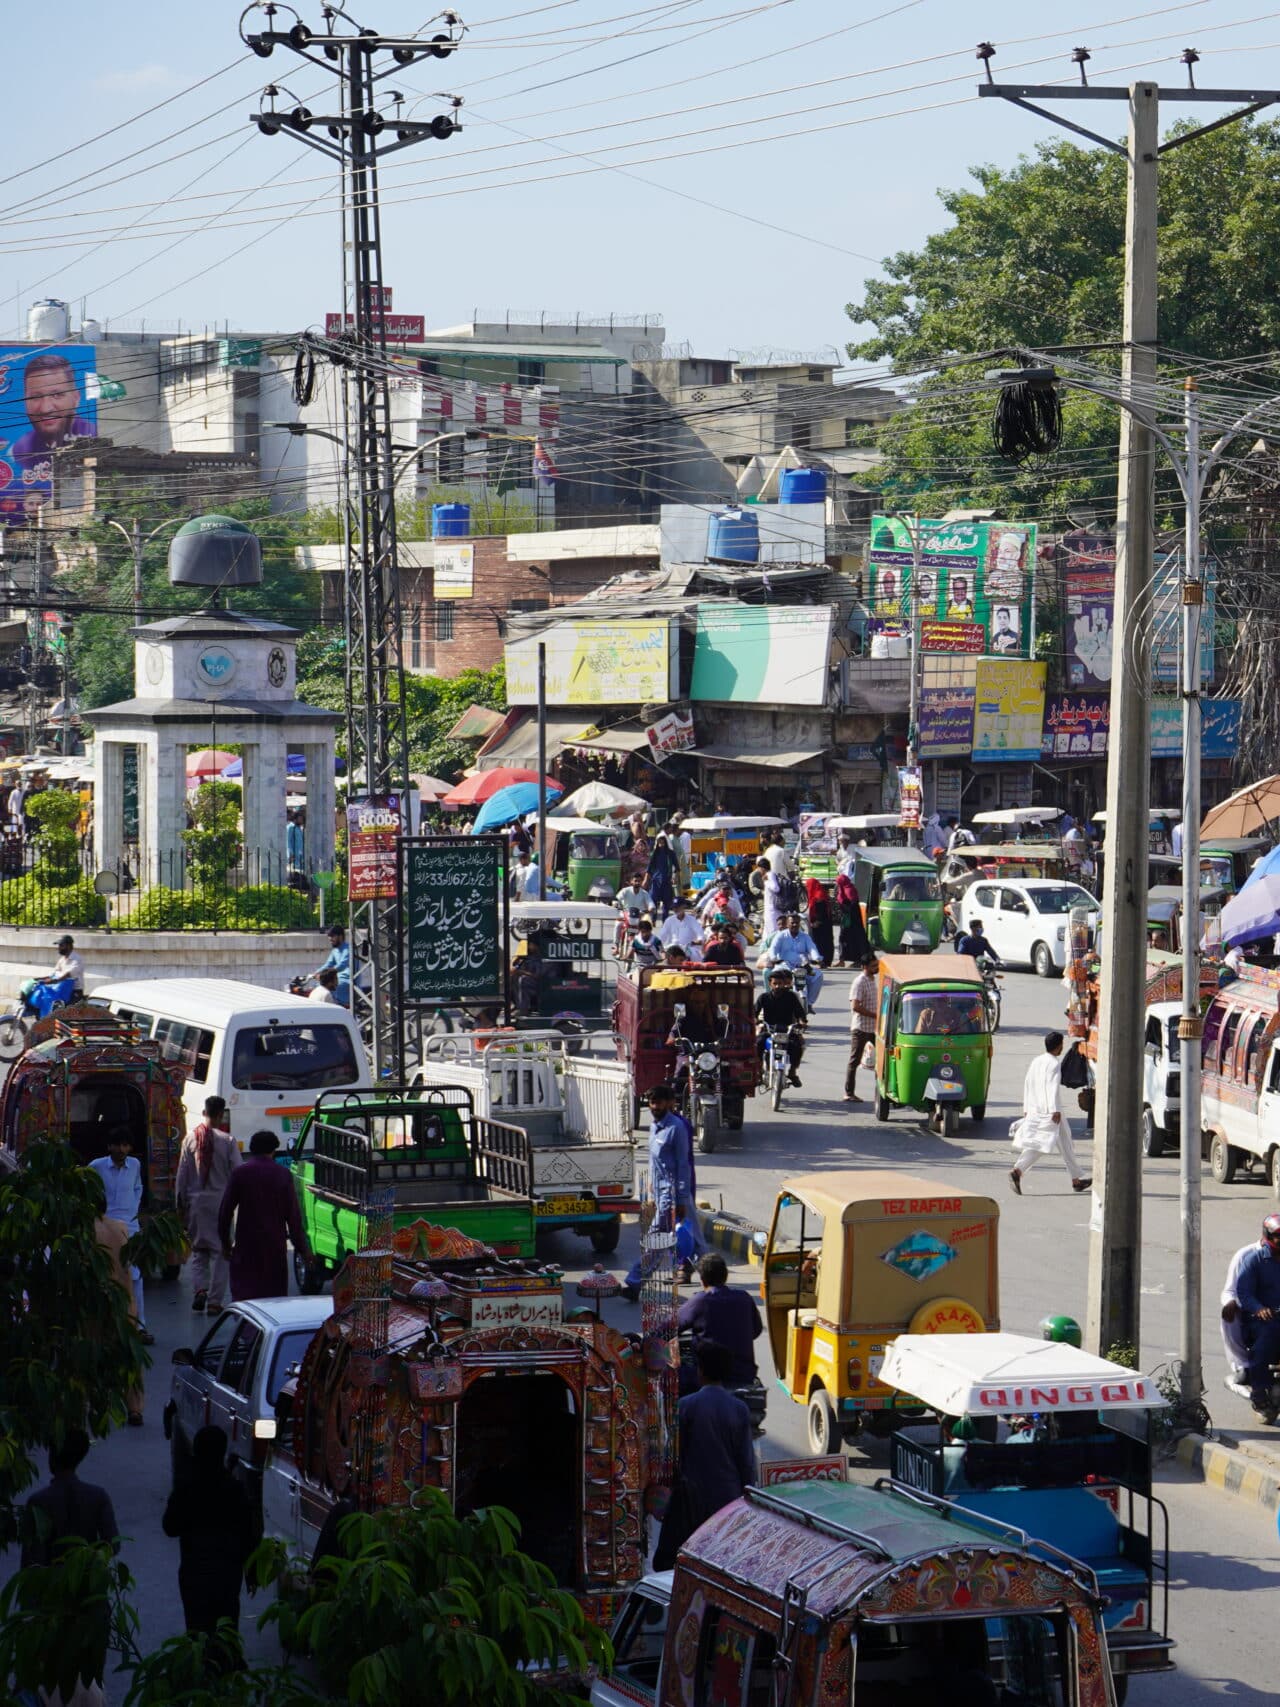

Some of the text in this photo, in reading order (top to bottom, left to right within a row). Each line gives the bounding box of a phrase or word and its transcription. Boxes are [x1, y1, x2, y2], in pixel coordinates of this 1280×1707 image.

[358, 813, 400, 827] FLOODS
[430, 873, 444, 886] 33
[453, 873, 468, 886] 67
[413, 889, 484, 932] شیخ رشید احمد
[425, 930, 488, 971] شیخ راشد شفیق
[548, 942, 595, 958] QINGQI
[881, 1199, 963, 1215] TEZ RAFTAR
[978, 1382, 1147, 1408] QINGQI
[896, 1445, 935, 1495] QINGQI
